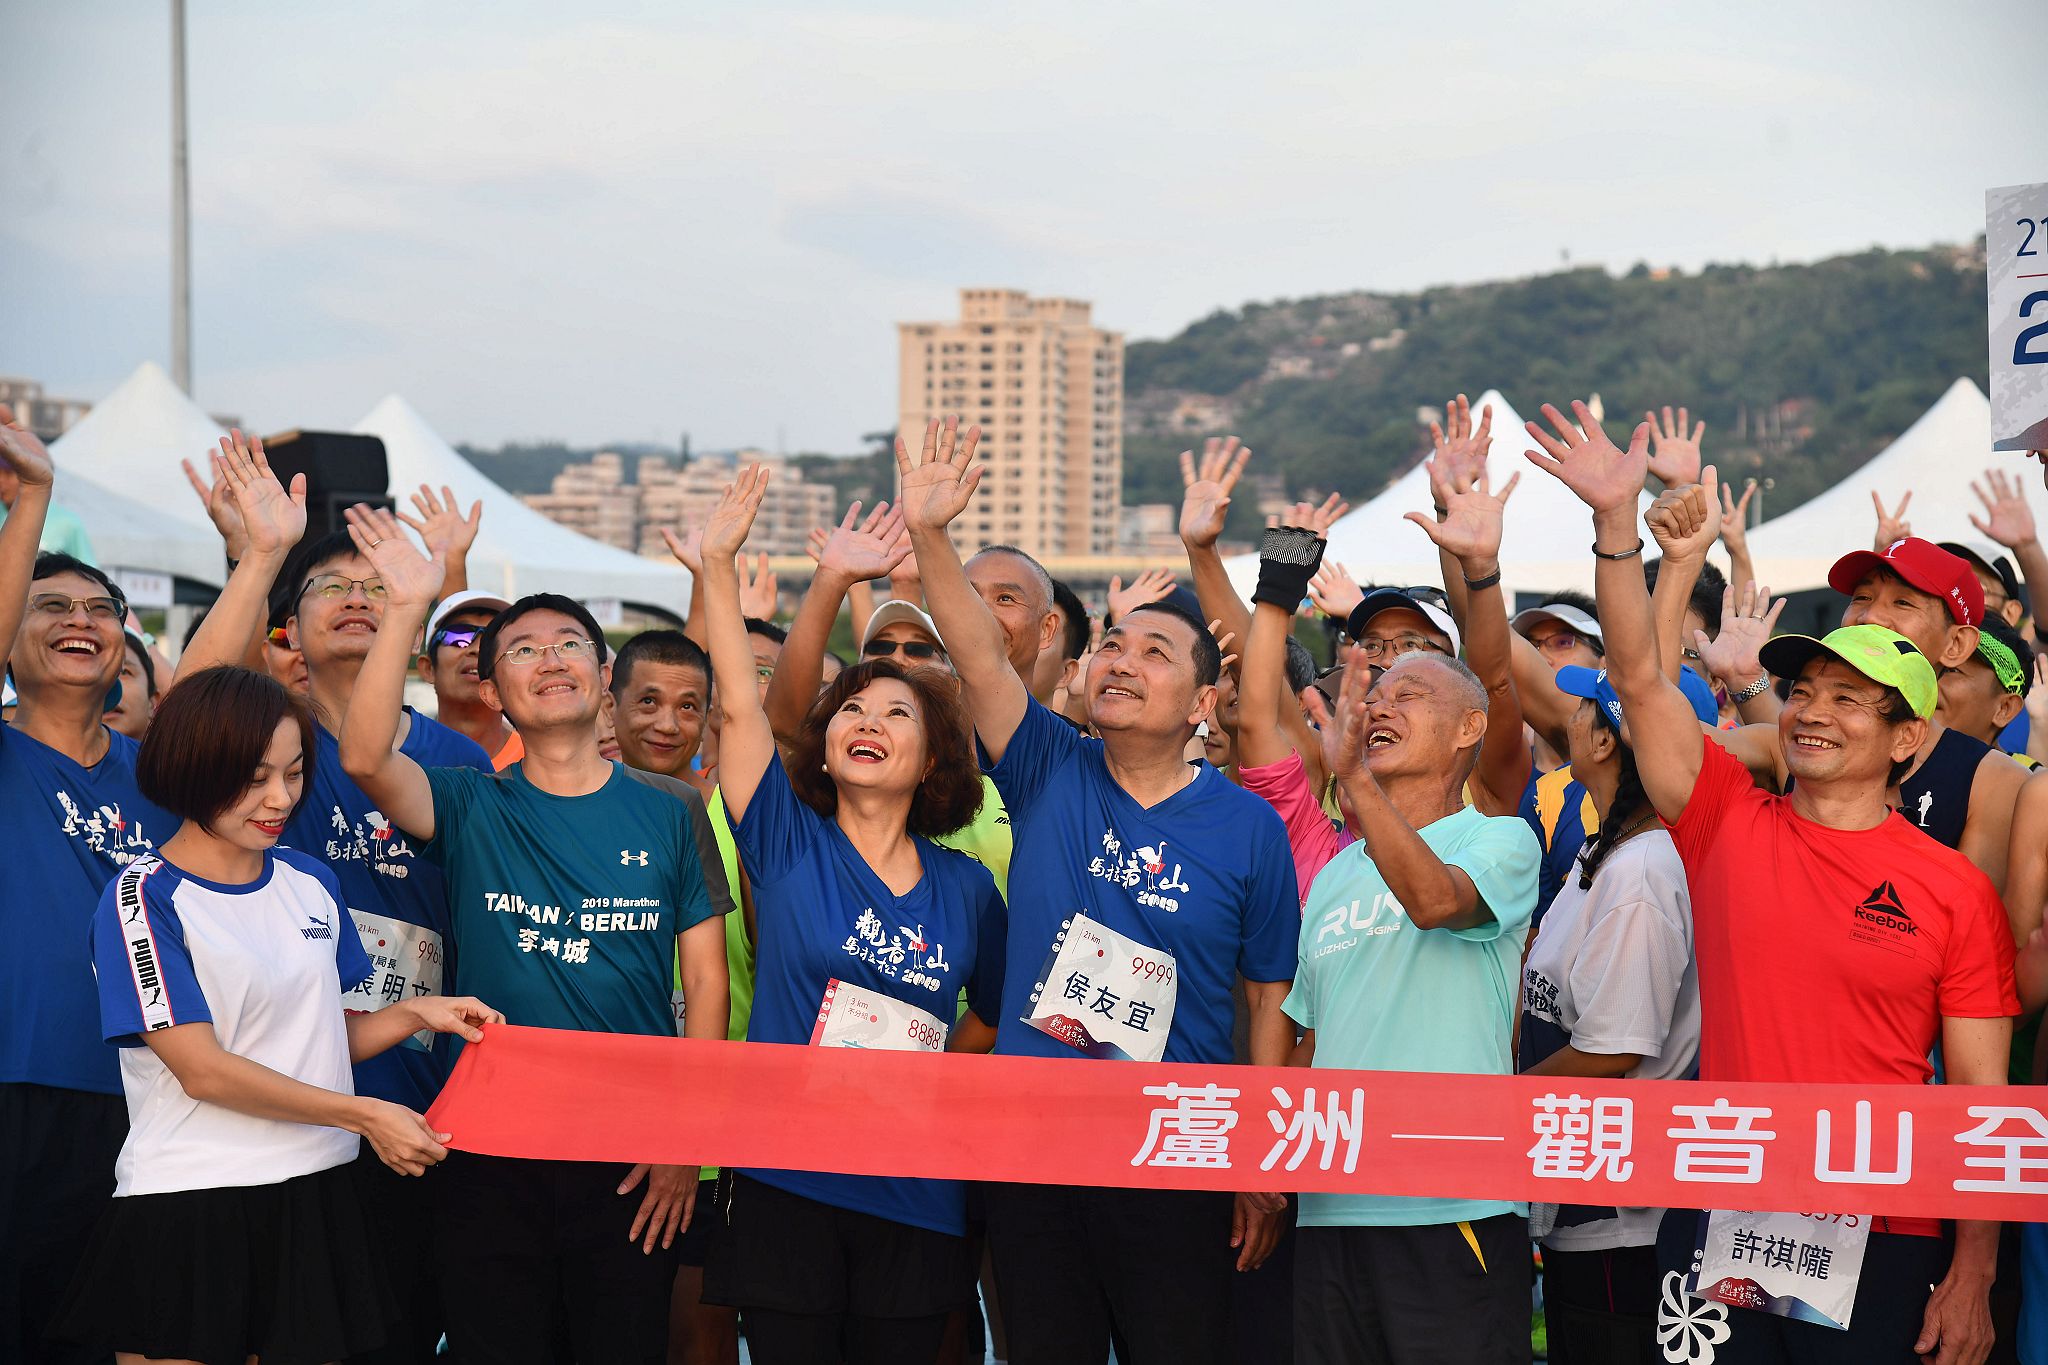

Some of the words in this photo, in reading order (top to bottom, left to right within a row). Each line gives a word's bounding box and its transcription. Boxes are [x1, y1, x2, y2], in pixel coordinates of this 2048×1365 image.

[581, 898, 610, 909] 2019
[613, 896, 660, 908] Marathon
[1137, 890, 1179, 913] 2019
[367, 925, 380, 936] km
[580, 912, 660, 932] BERLIN
[1854, 905, 1919, 937] Reebok
[300, 927, 333, 940] PUMA
[1083, 930, 1092, 940] 21
[1091, 933, 1101, 945] km
[132, 938, 160, 990] PUMA
[418, 940, 443, 967] 996
[842, 936, 898, 978] 馬拉松
[902, 968, 941, 992] 2019
[1131, 956, 1173, 986] 9999
[850, 997, 856, 1006] 3
[857, 999, 869, 1010] km
[1063, 970, 1156, 1033] 侯友宜
[907, 1019, 941, 1050] 8888
